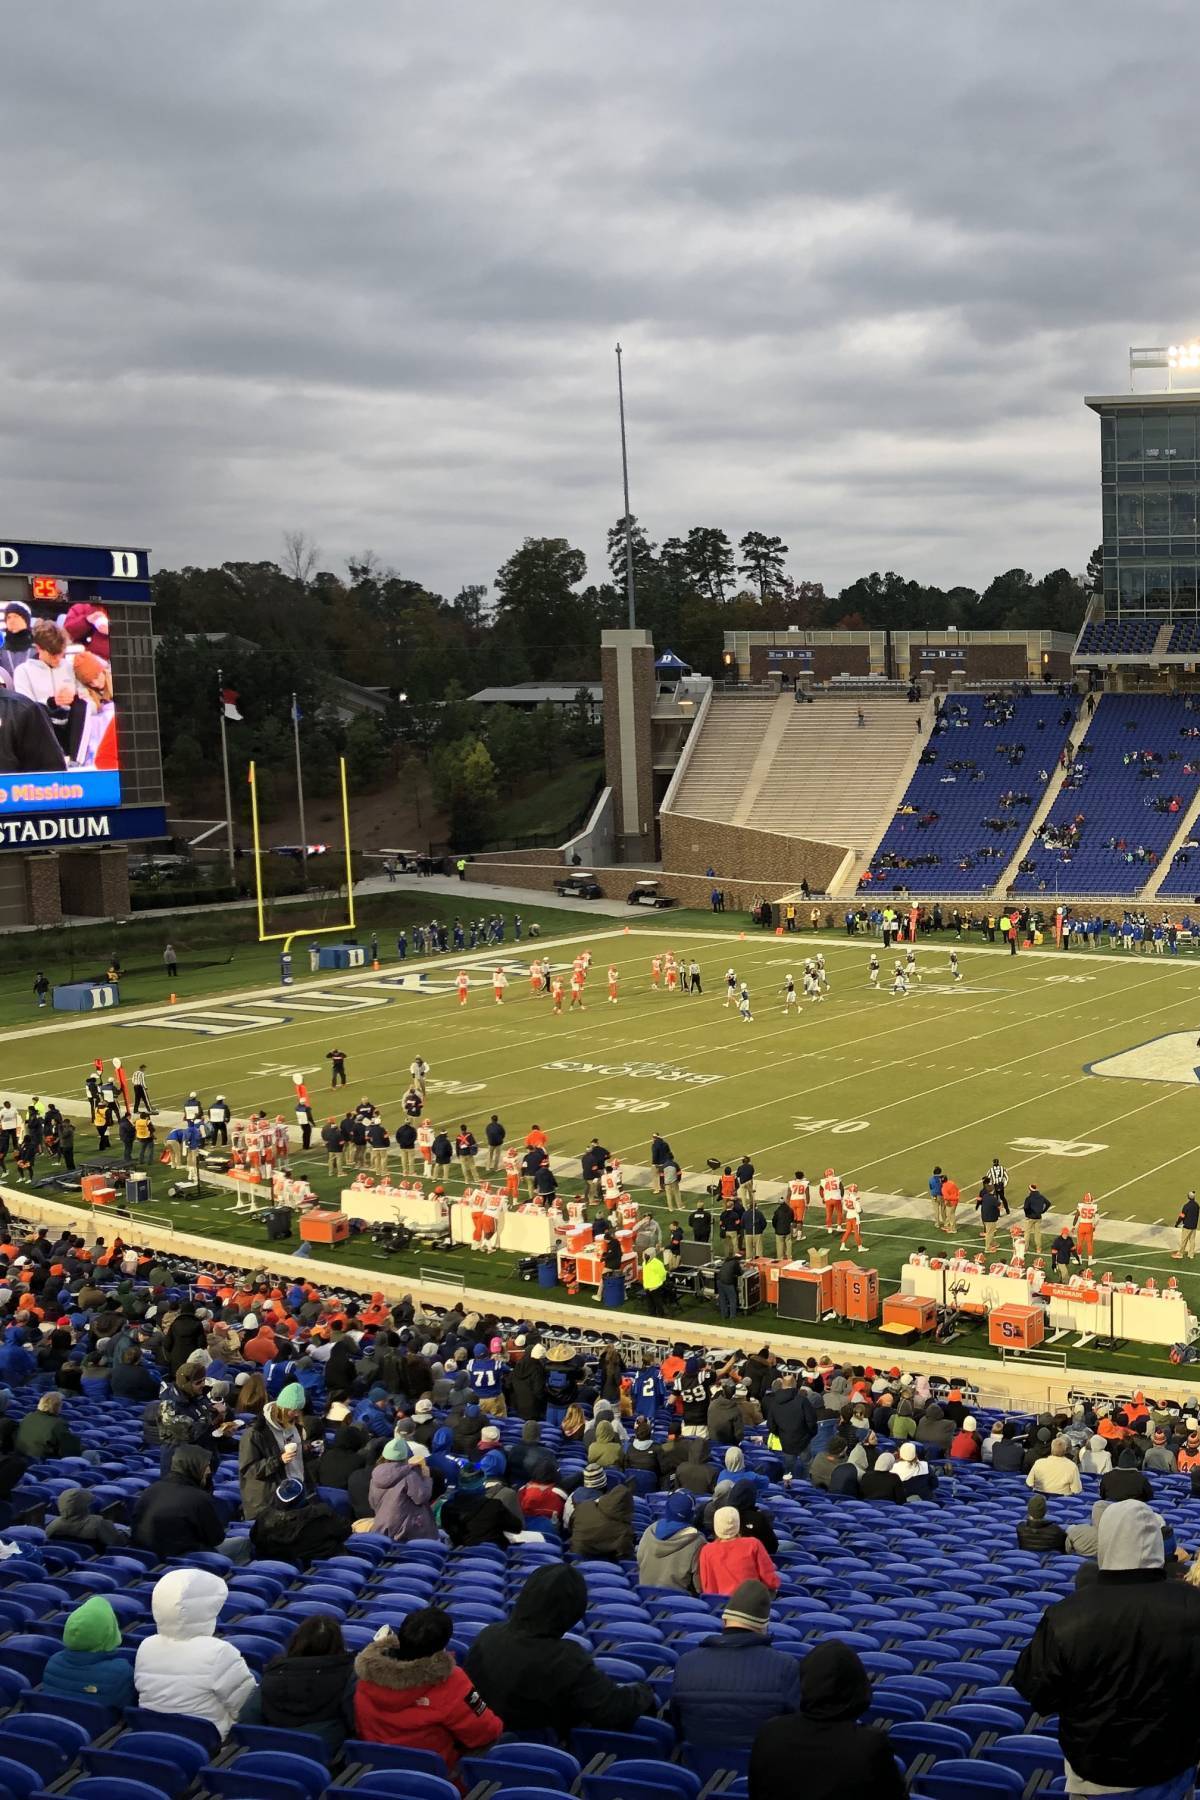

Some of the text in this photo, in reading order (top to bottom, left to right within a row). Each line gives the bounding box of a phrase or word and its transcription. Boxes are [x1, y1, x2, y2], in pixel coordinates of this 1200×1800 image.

[35, 579, 56, 597] 25
[12, 783, 84, 802] Mission
[541, 1061, 727, 1084] BROOKS
[595, 1098, 671, 1113] 30
[792, 1117, 871, 1134] 40
[853, 1282, 861, 1295] S
[473, 1370, 497, 1387] 71
[642, 1377, 655, 1398] 2
[681, 1385, 708, 1404] 69
